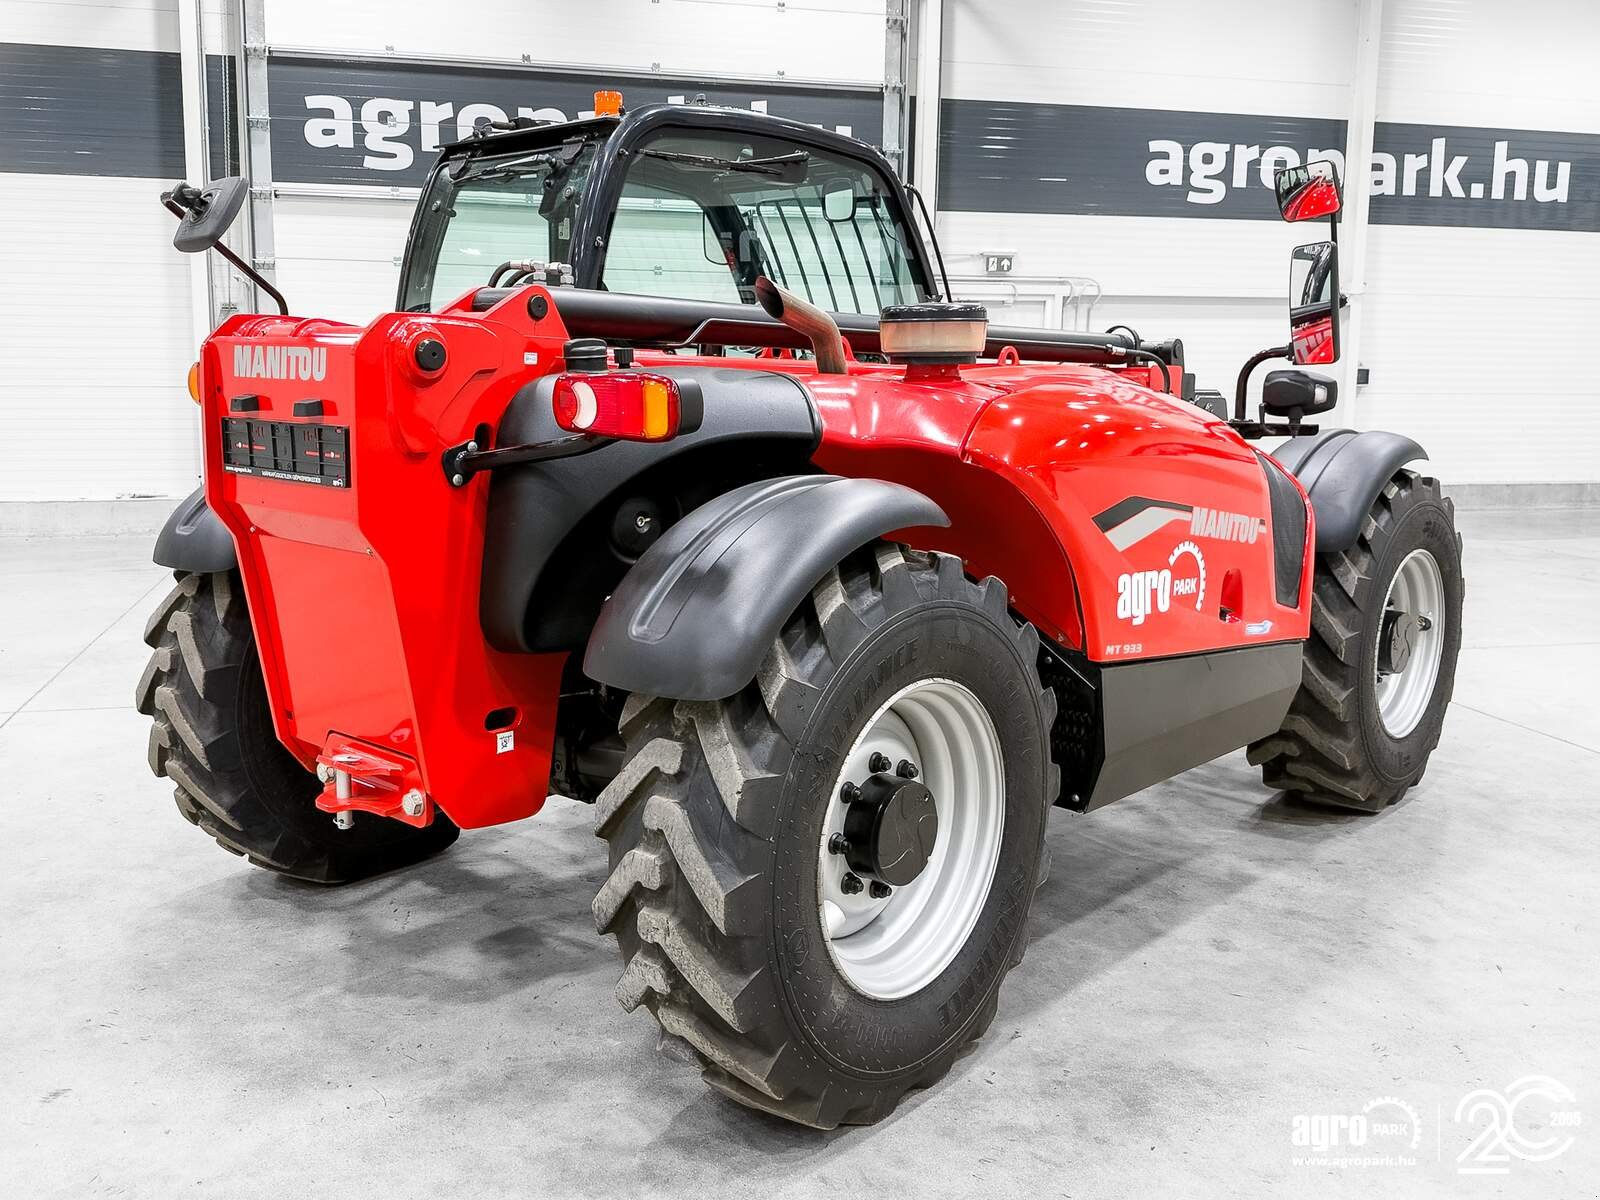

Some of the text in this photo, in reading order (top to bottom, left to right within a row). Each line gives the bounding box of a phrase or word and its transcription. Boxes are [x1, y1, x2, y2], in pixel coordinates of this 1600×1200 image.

[233, 345, 327, 381] MANITOU
[1190, 506, 1259, 544] MANITOU
[1117, 569, 1197, 625] agro PARK
[1105, 644, 1143, 655] MT 933
